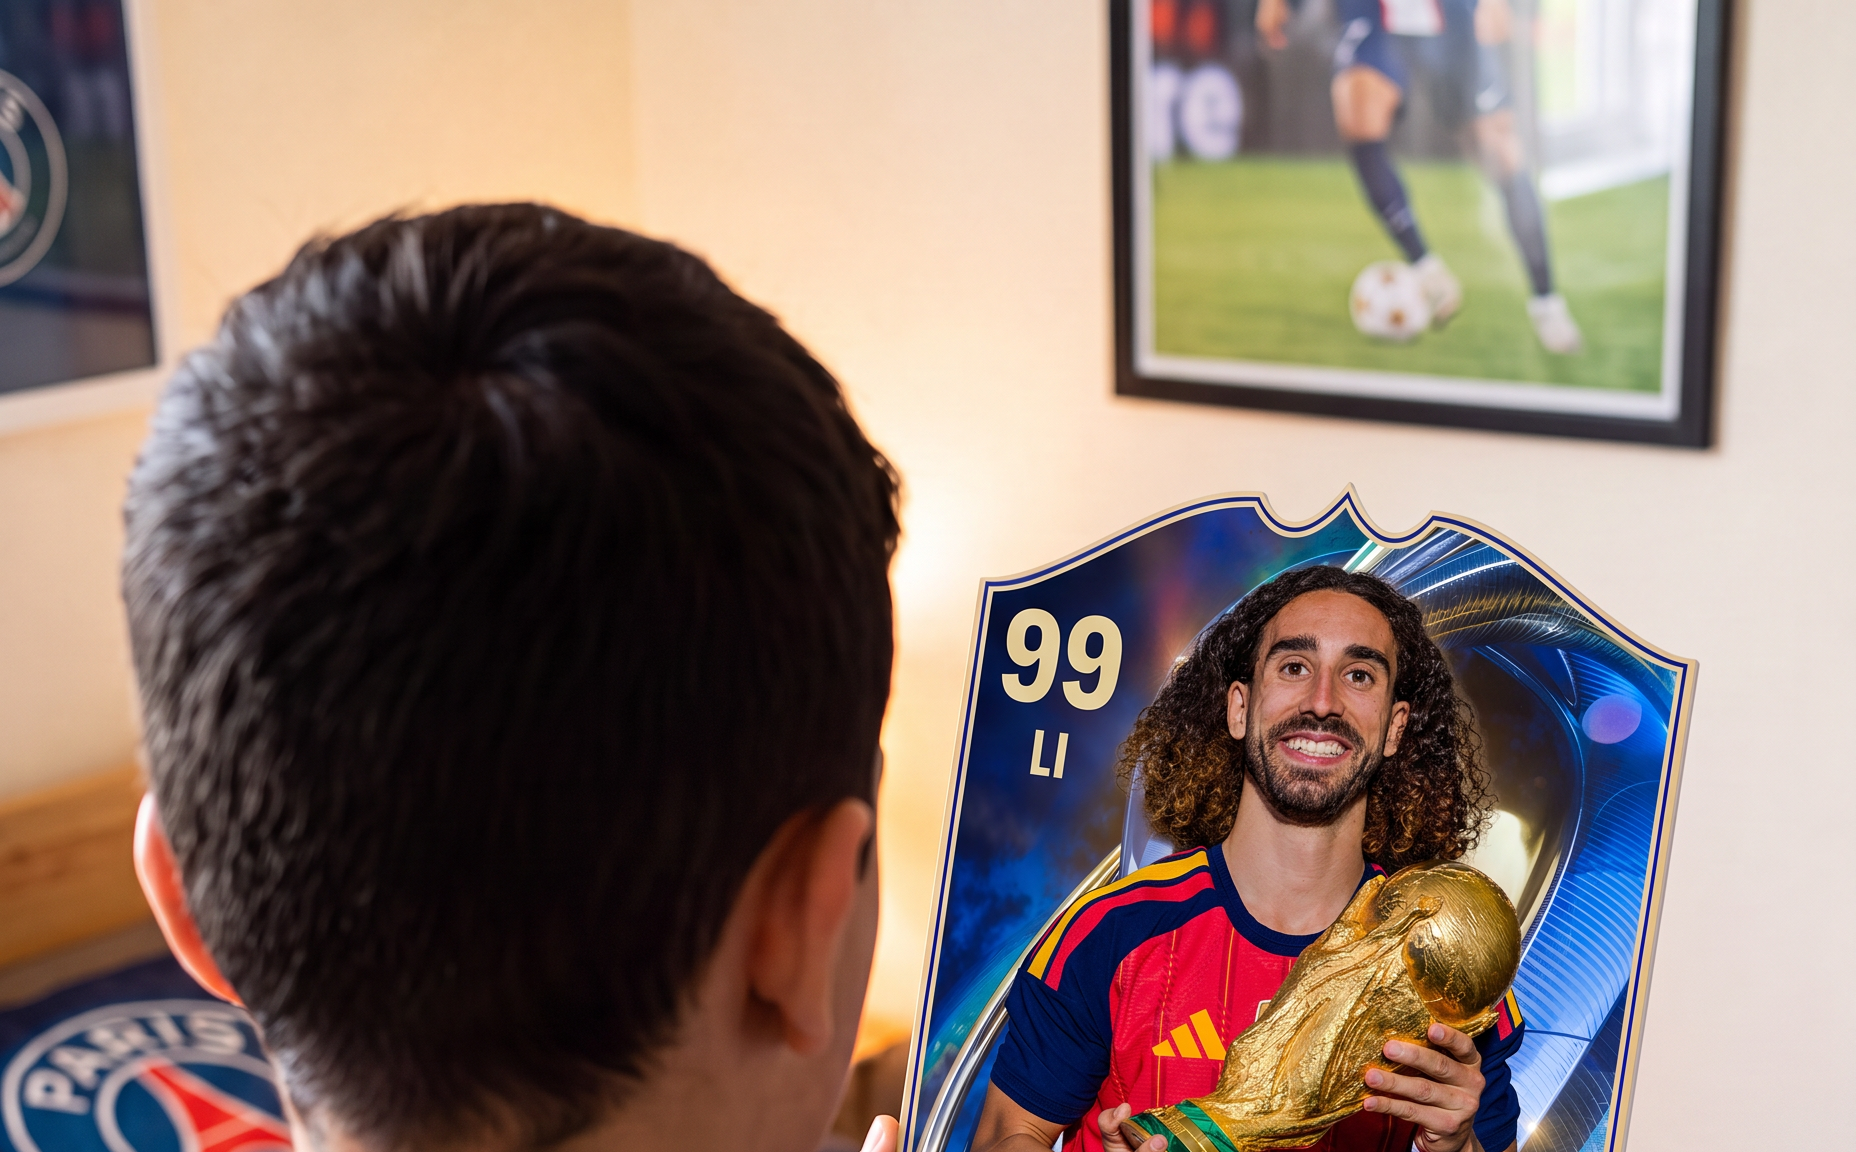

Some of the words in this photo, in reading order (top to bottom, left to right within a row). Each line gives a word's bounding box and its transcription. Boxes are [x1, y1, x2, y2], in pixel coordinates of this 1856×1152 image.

[1001, 608, 1123, 711] 99
[1030, 729, 1069, 779] LI
[24, 1009, 246, 1115] PARIS
